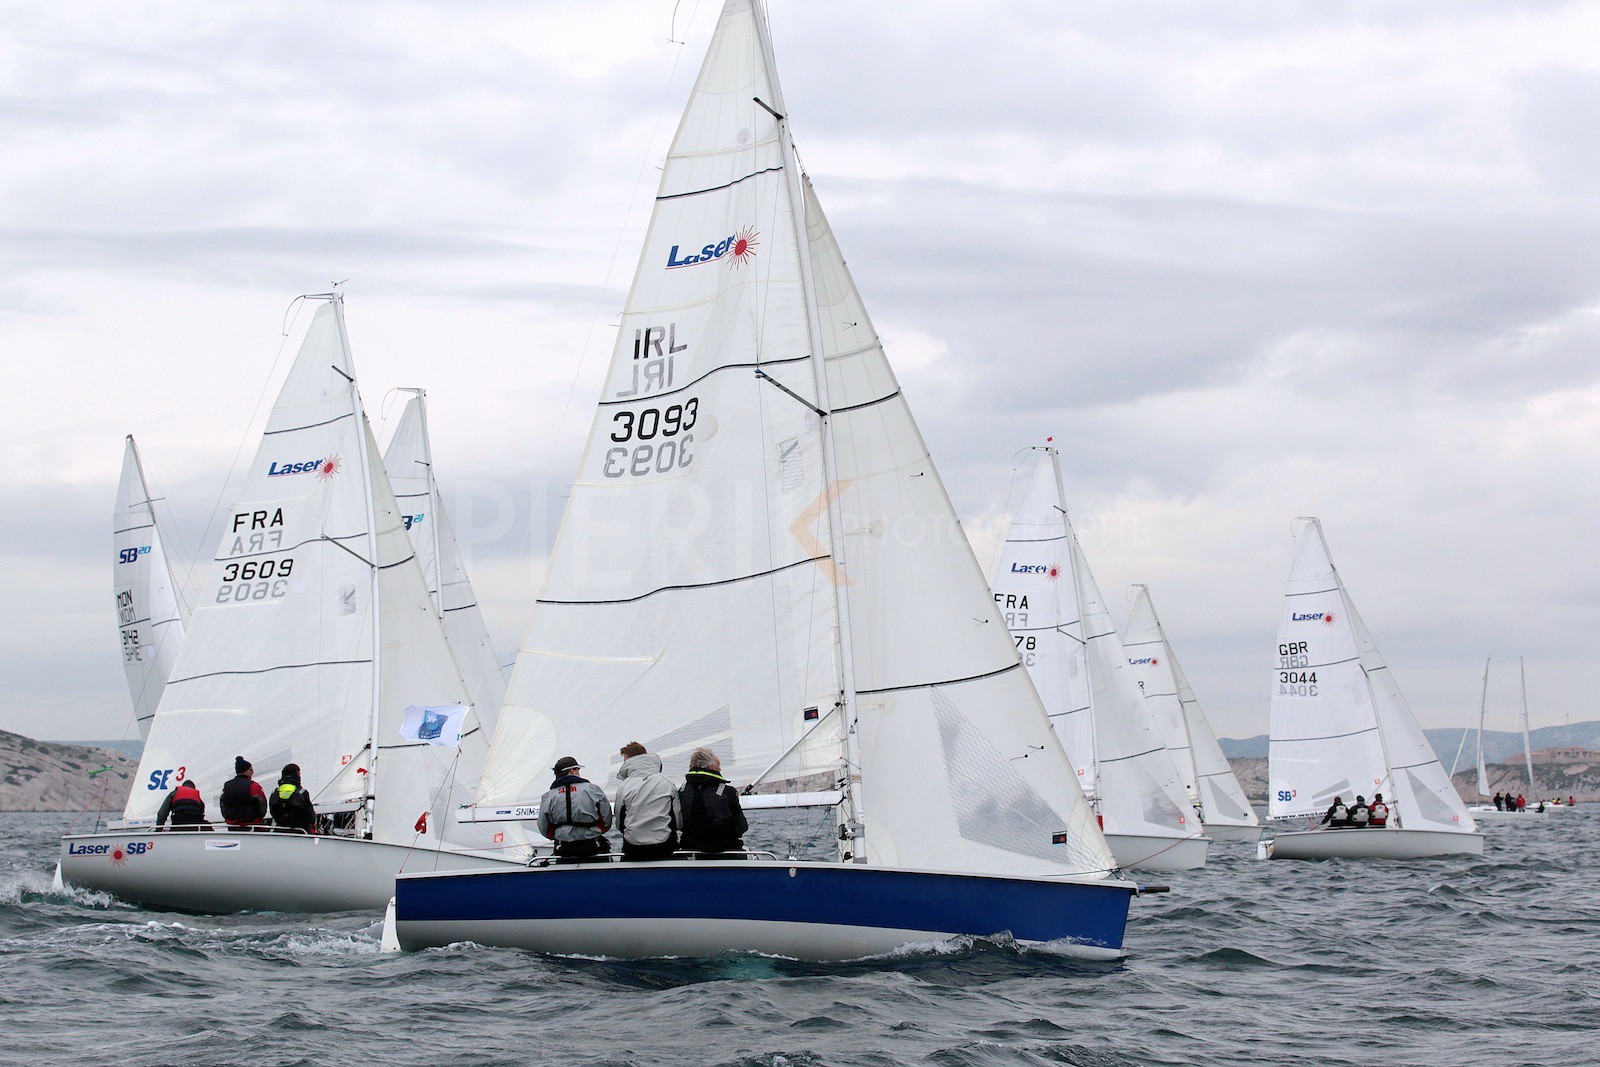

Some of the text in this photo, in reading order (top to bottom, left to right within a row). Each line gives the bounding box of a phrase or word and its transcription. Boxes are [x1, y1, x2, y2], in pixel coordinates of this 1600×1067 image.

[666, 234, 735, 267] Laser
[634, 322, 688, 360] IRL
[610, 397, 699, 442] 3093
[268, 458, 323, 476] Laser
[233, 508, 284, 533] FRA
[223, 558, 294, 582] 3609
[1011, 562, 1047, 573] Laser
[117, 589, 133, 609] MON
[994, 593, 1029, 610] FRA
[1292, 612, 1324, 621] Laser
[1279, 641, 1308, 656] GBR
[1279, 671, 1318, 684] 3044
[68, 842, 110, 855] Laser
